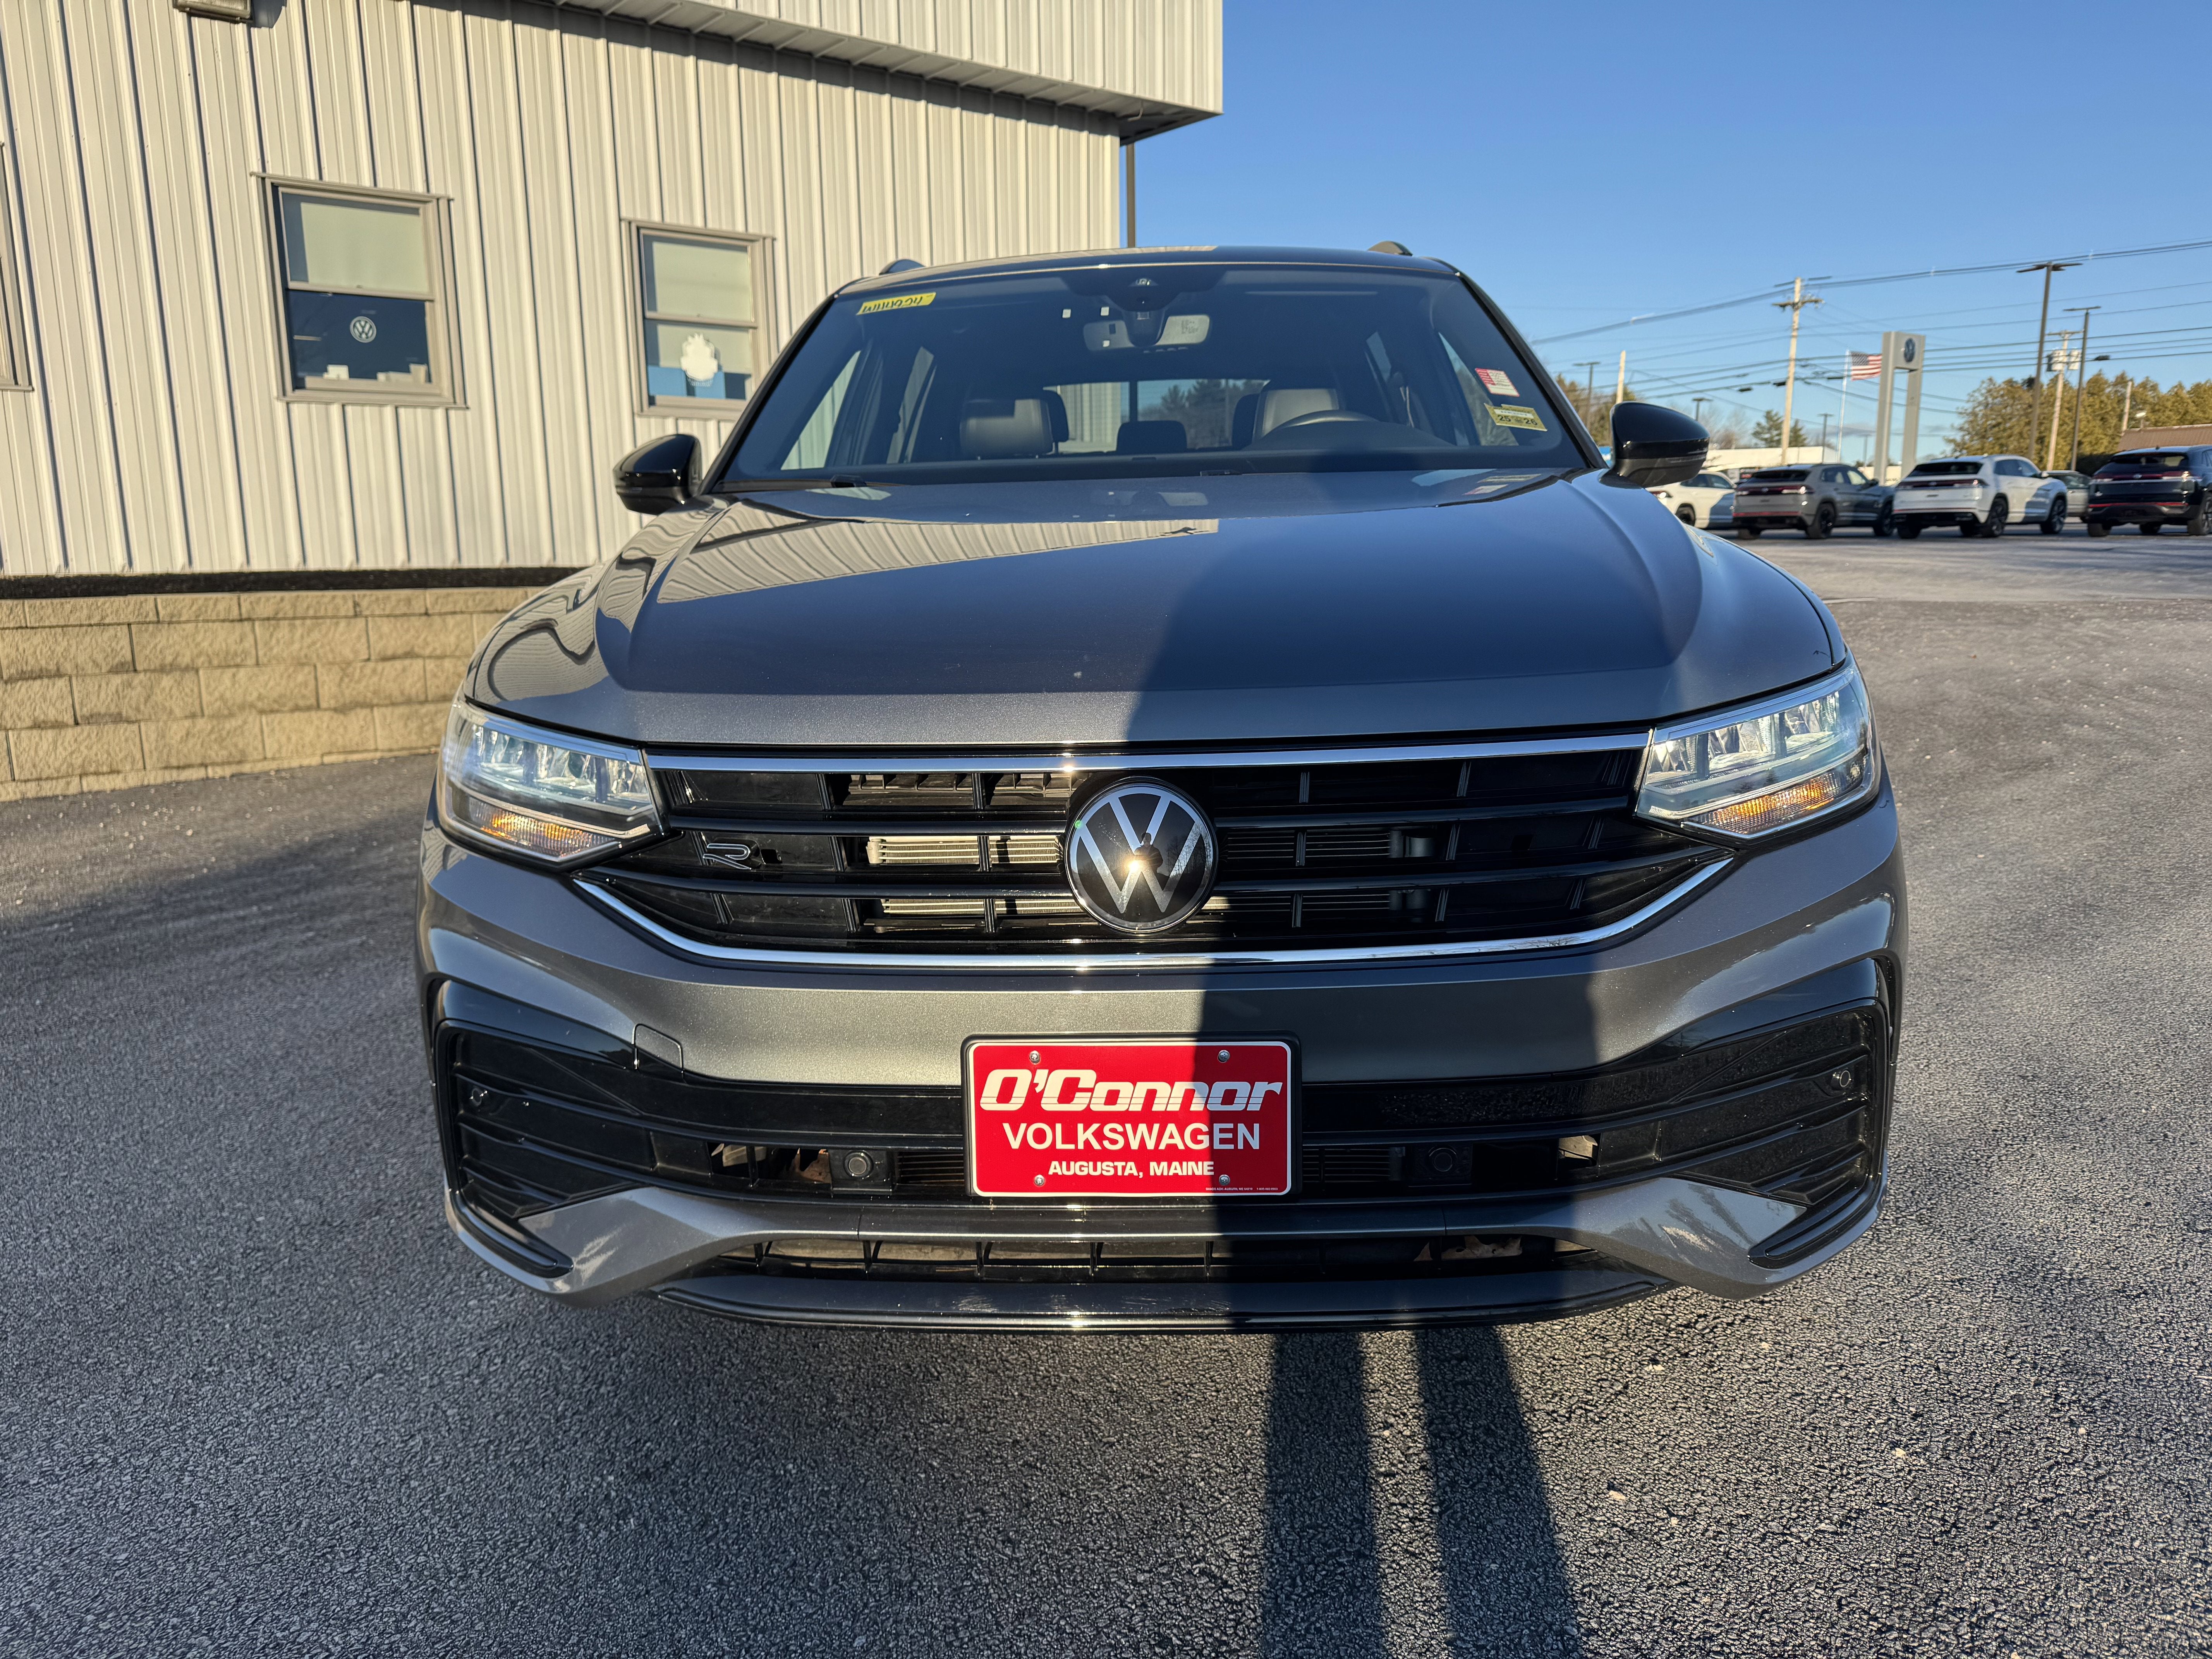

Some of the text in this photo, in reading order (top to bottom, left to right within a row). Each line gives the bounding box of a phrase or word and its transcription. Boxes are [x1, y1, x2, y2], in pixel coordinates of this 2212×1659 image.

[703, 843, 751, 870] R
[980, 1069, 1283, 1111] O'Connor
[1002, 1122, 1259, 1150] VOLKSWAGEN
[1048, 1161, 1214, 1178] AUGUSTA, MAINE
